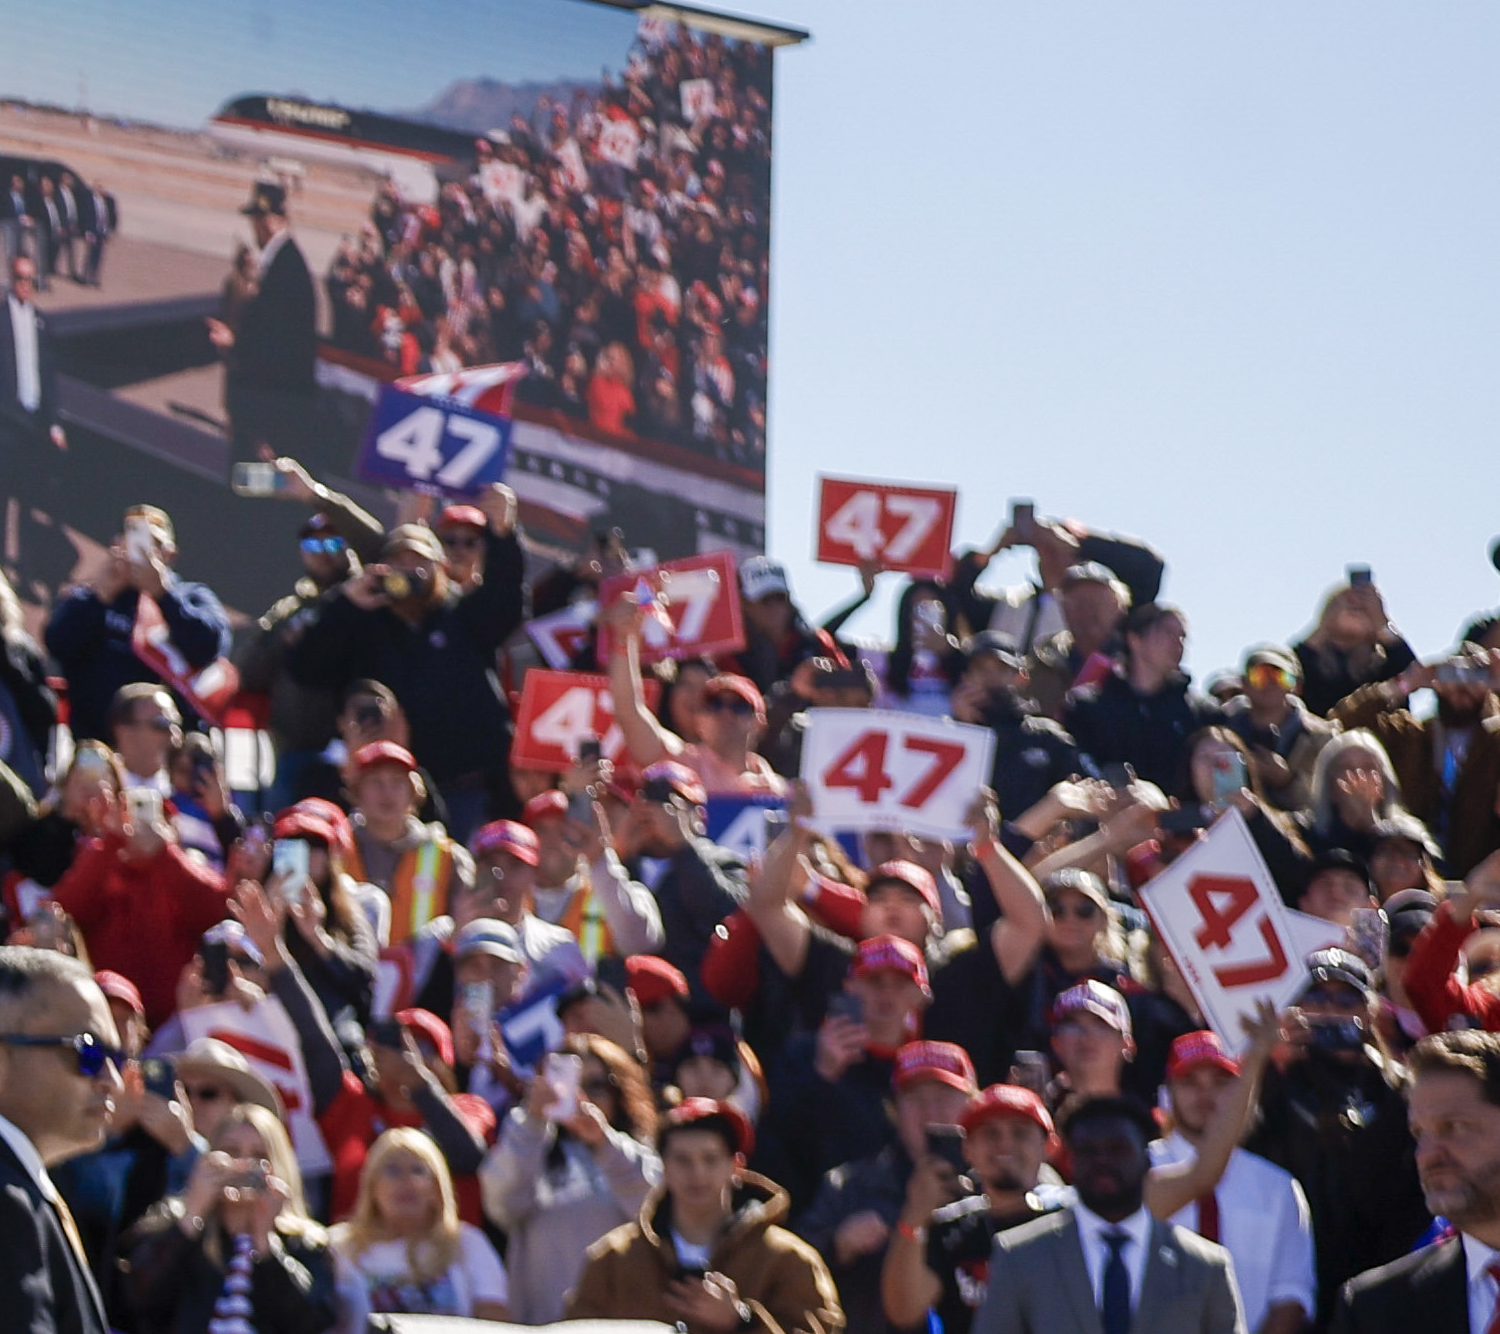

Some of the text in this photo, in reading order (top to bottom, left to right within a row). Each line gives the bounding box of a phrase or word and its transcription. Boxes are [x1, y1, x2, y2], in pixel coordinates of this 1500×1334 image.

[376, 405, 500, 489] 47
[825, 490, 943, 560] 47
[642, 570, 720, 646] 7
[824, 730, 967, 808] 47
[1187, 872, 1290, 988] 47
